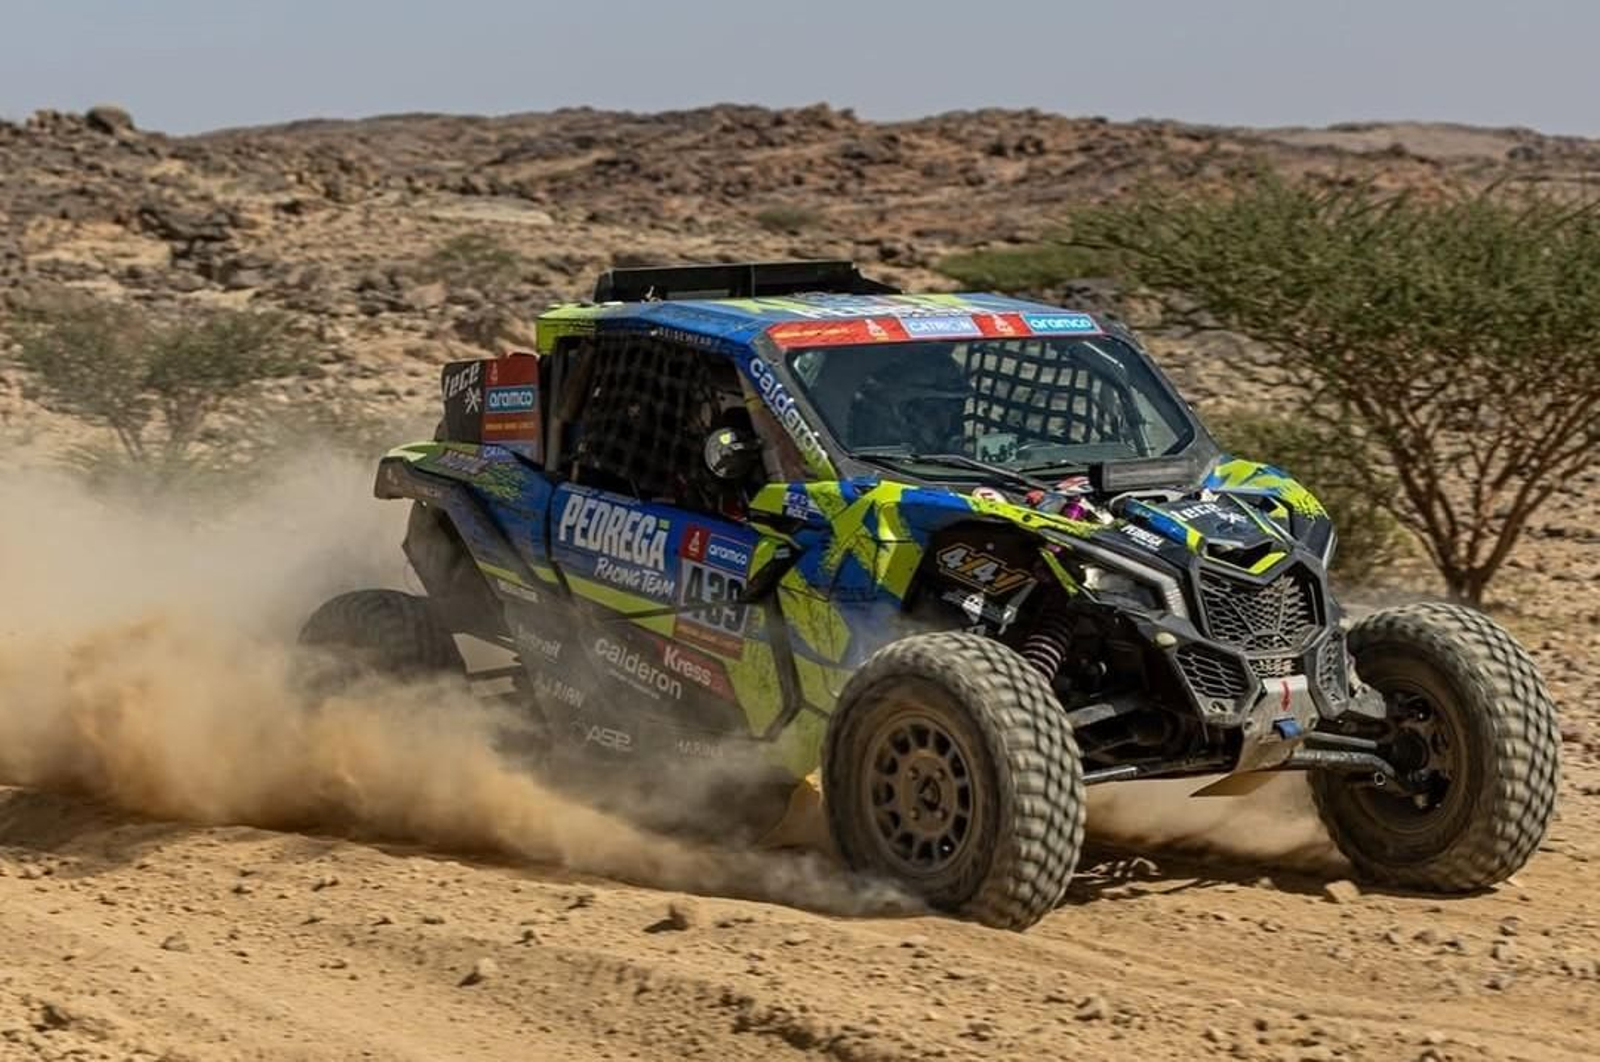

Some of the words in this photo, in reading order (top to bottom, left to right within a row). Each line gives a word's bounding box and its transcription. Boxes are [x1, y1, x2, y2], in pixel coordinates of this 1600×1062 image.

[1031, 317, 1091, 331] aramco
[489, 391, 533, 407] aramco
[708, 543, 748, 566] aramco
[594, 558, 642, 587] RACING
[640, 570, 675, 598] TEAM
[595, 638, 682, 700] calderon
[664, 646, 711, 686] Kress
